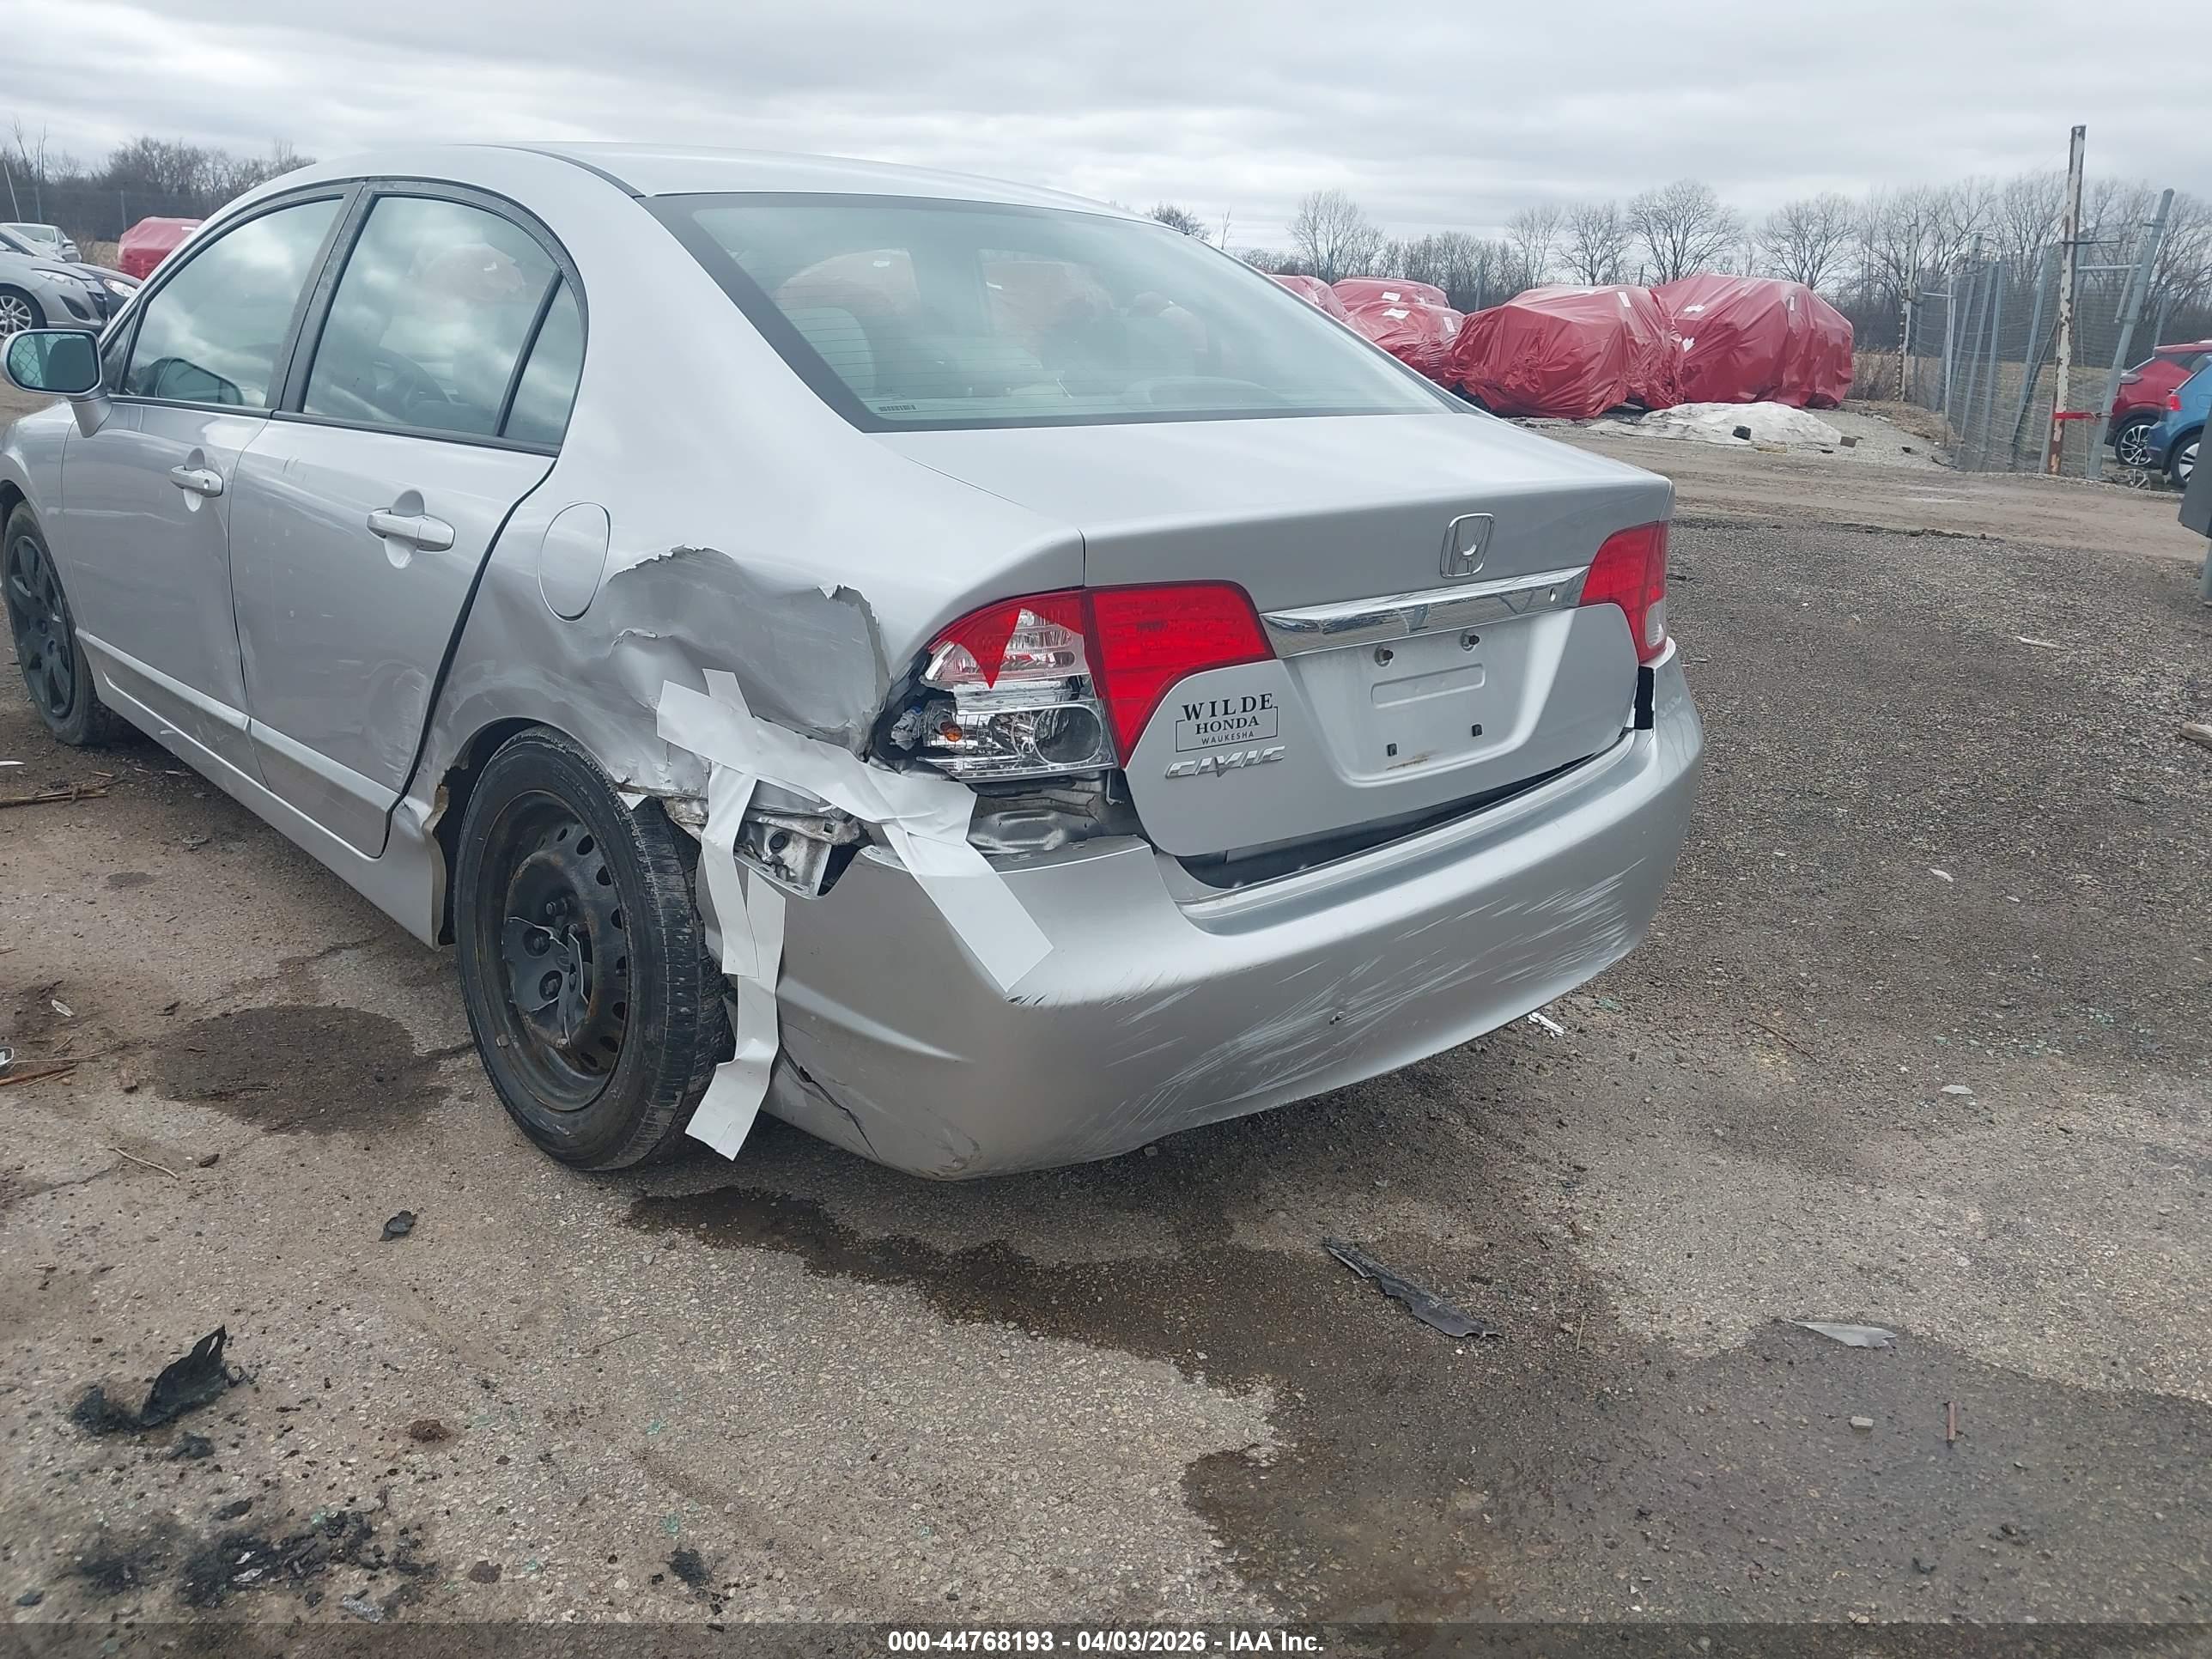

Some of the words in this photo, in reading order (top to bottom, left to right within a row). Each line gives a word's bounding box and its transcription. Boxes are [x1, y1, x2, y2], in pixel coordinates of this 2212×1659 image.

[1182, 693, 1273, 721] WILDE
[1195, 715, 1260, 735] HONDA
[1201, 731, 1255, 745] WAUKESHA
[1164, 745, 1285, 779] CIVIC
